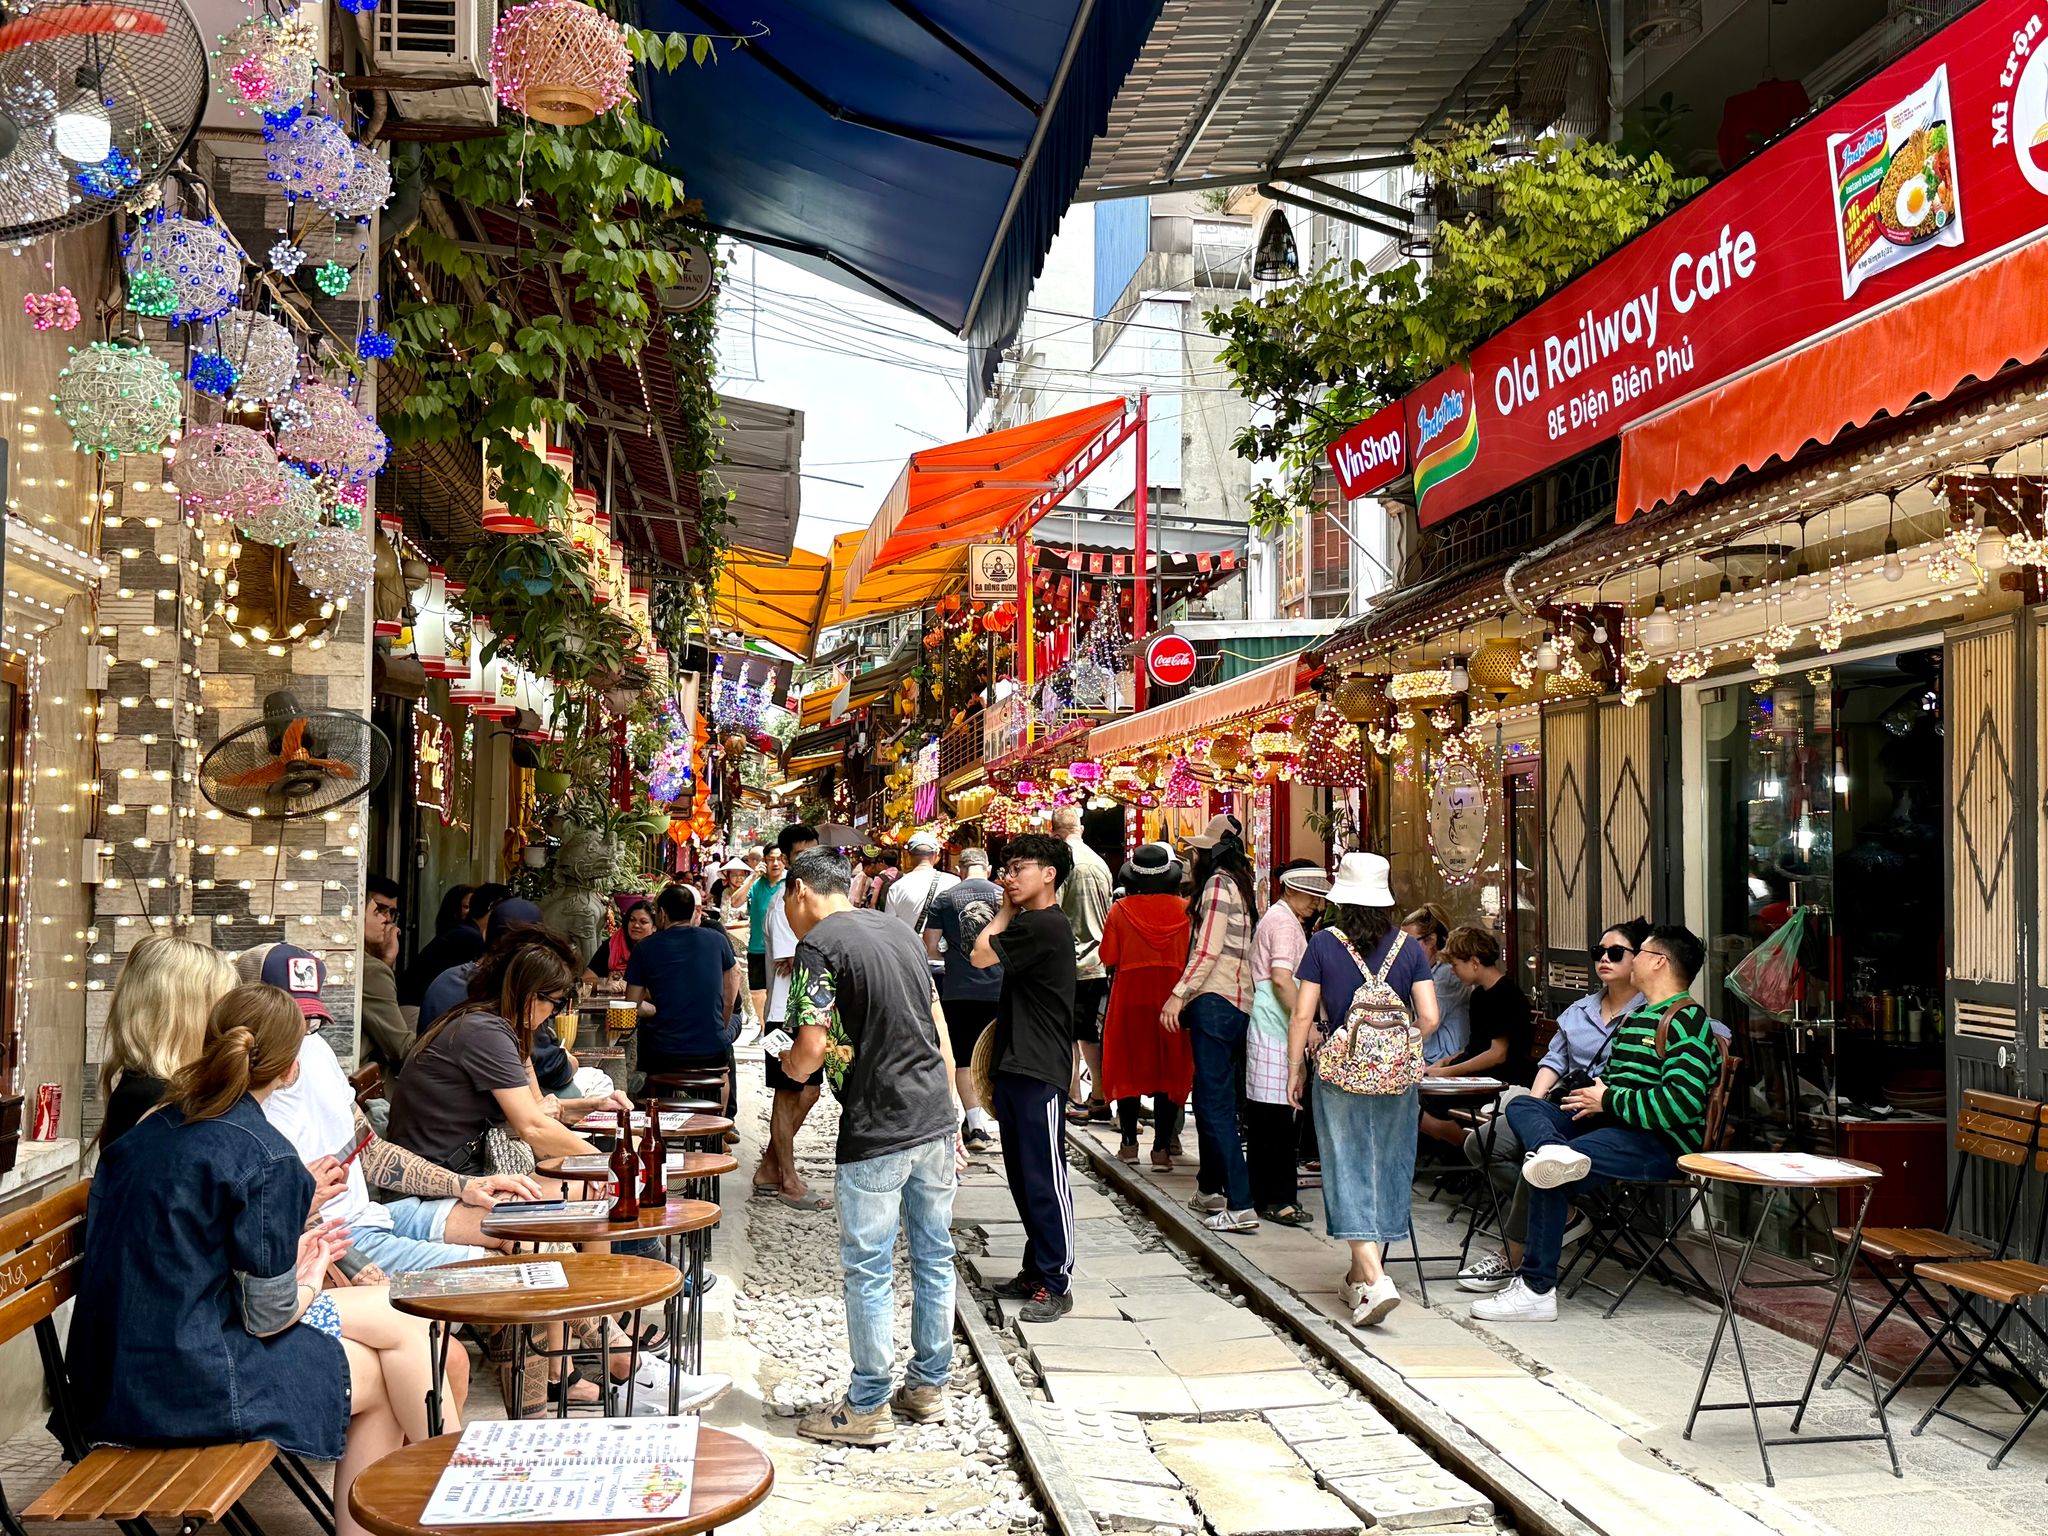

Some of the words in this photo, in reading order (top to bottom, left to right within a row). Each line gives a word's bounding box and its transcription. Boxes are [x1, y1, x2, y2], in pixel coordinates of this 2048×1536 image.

[2000, 14, 2042, 87] trộn
[1845, 179, 1862, 194] Instant
[1862, 167, 1884, 184] Noodles
[1495, 349, 1539, 415] Old
[1544, 286, 1658, 389] Railway
[1669, 224, 1757, 313] Cafe
[1547, 407, 1567, 440] 8E
[1570, 388, 1609, 428] Điện
[1612, 365, 1652, 407] Biên
[1656, 335, 1694, 384] Phủ
[1336, 430, 1401, 488] VinShop
